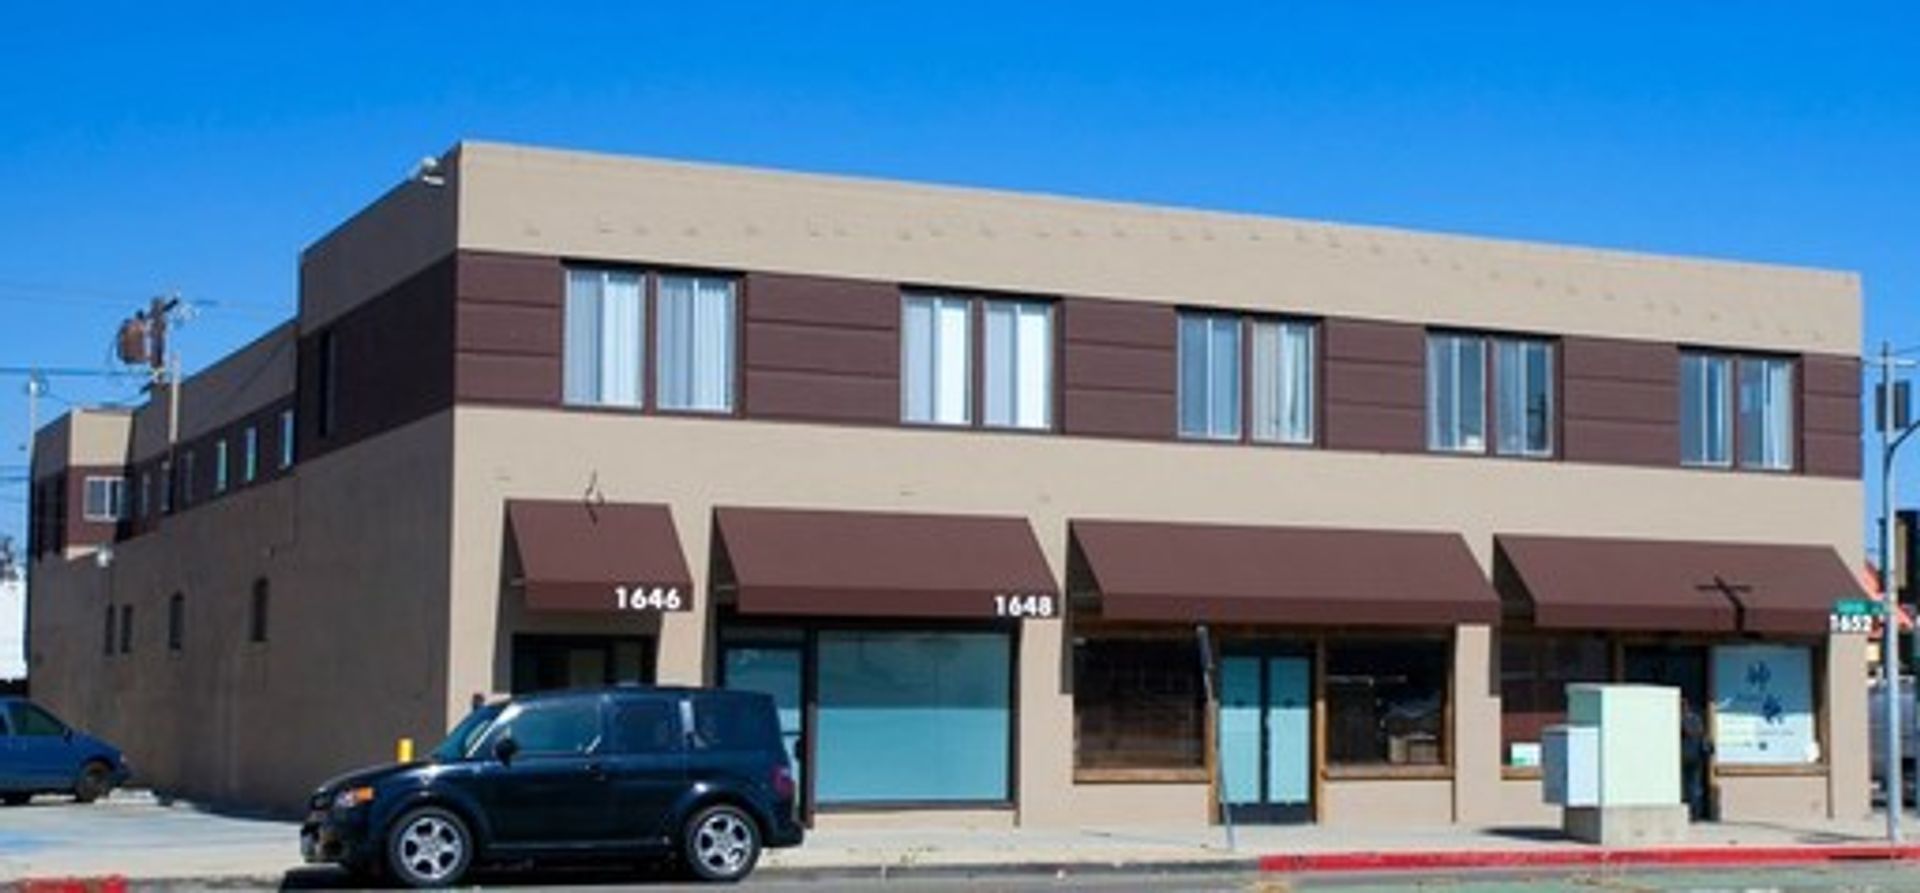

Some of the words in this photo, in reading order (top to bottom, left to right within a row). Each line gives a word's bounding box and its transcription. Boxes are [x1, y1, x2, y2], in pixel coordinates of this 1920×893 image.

[615, 586, 681, 609] 1646
[994, 595, 1052, 617] 1648
[1830, 614, 1872, 632] 1652
